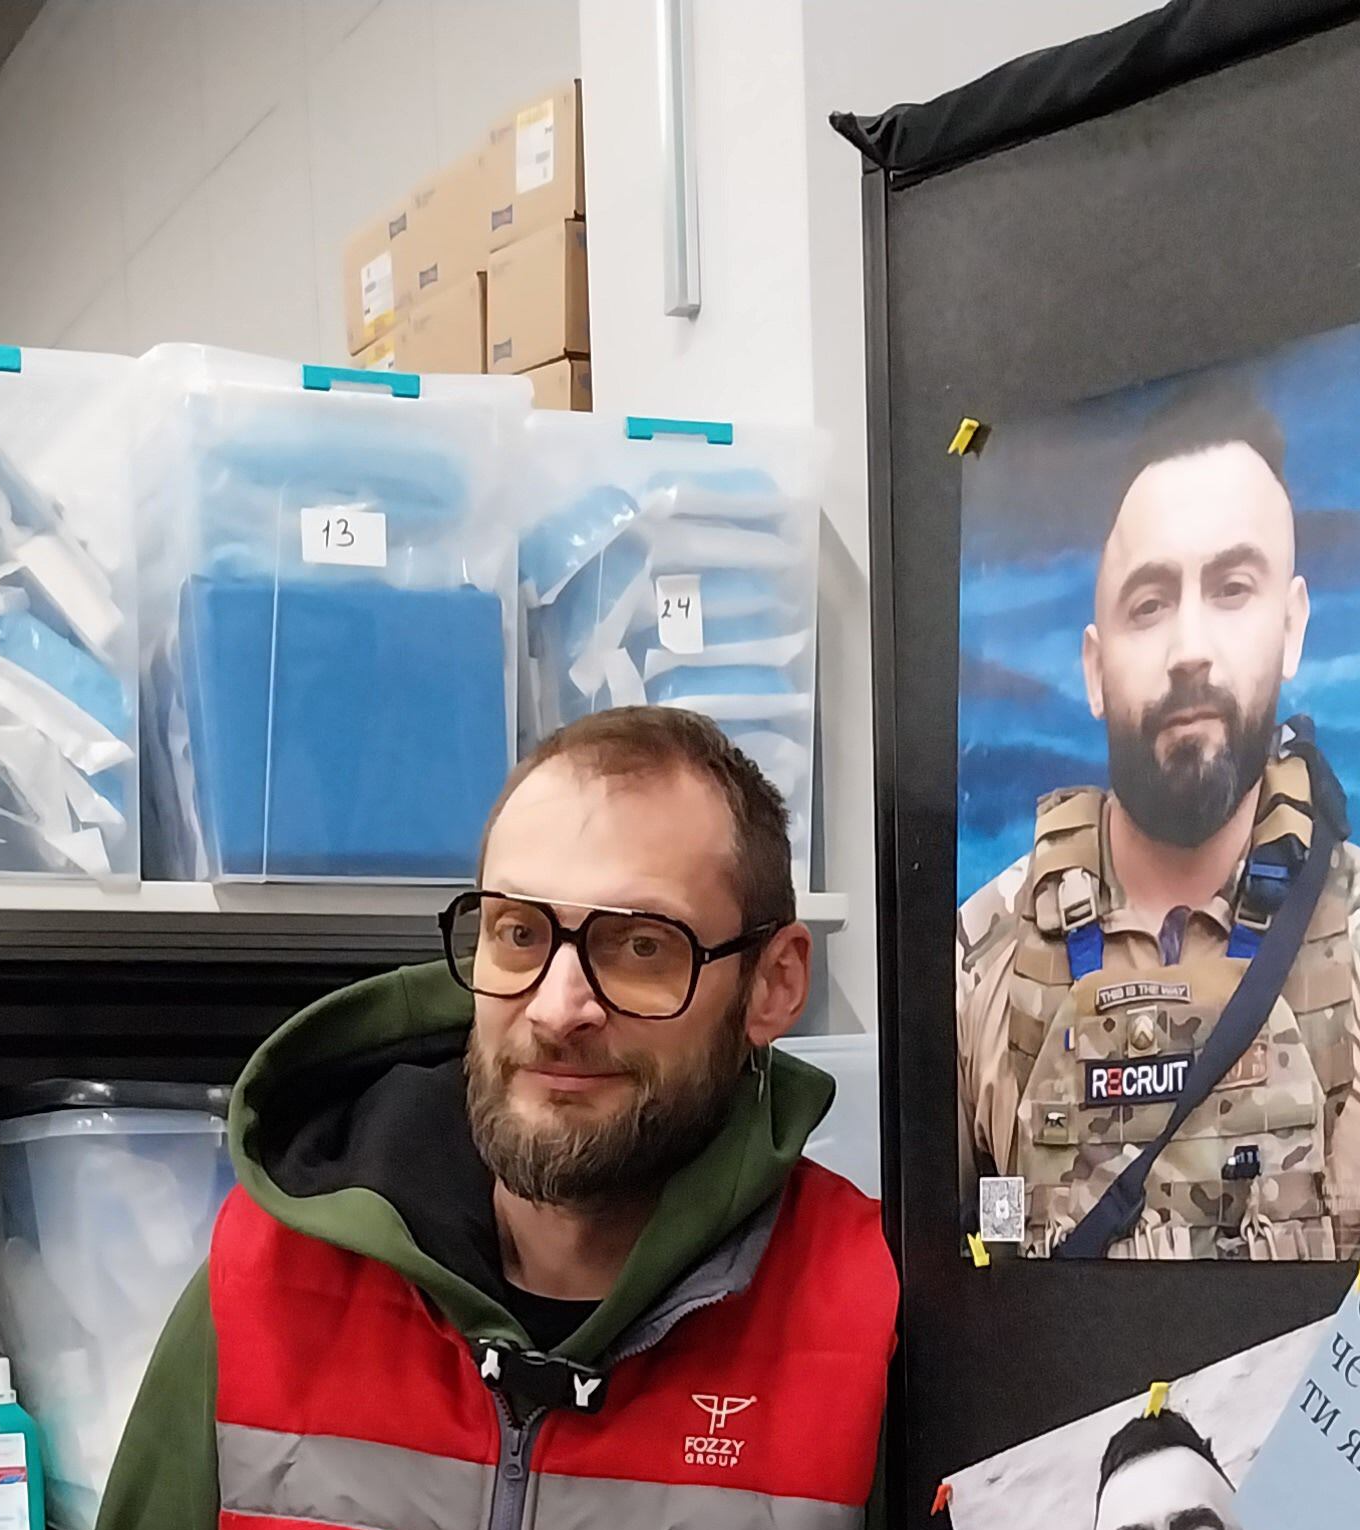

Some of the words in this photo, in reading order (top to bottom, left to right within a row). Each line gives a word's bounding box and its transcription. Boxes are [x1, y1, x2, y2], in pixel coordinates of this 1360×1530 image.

[321, 518, 356, 549] 13
[661, 596, 691, 620] 24
[1138, 984, 1159, 995] THE
[1160, 985, 1187, 996] WAY
[1091, 1060, 1189, 1099] RECRUIT
[1297, 1378, 1344, 1437] ти
[684, 1436, 746, 1457] FOZZY
[684, 1453, 738, 1468] GROUP
